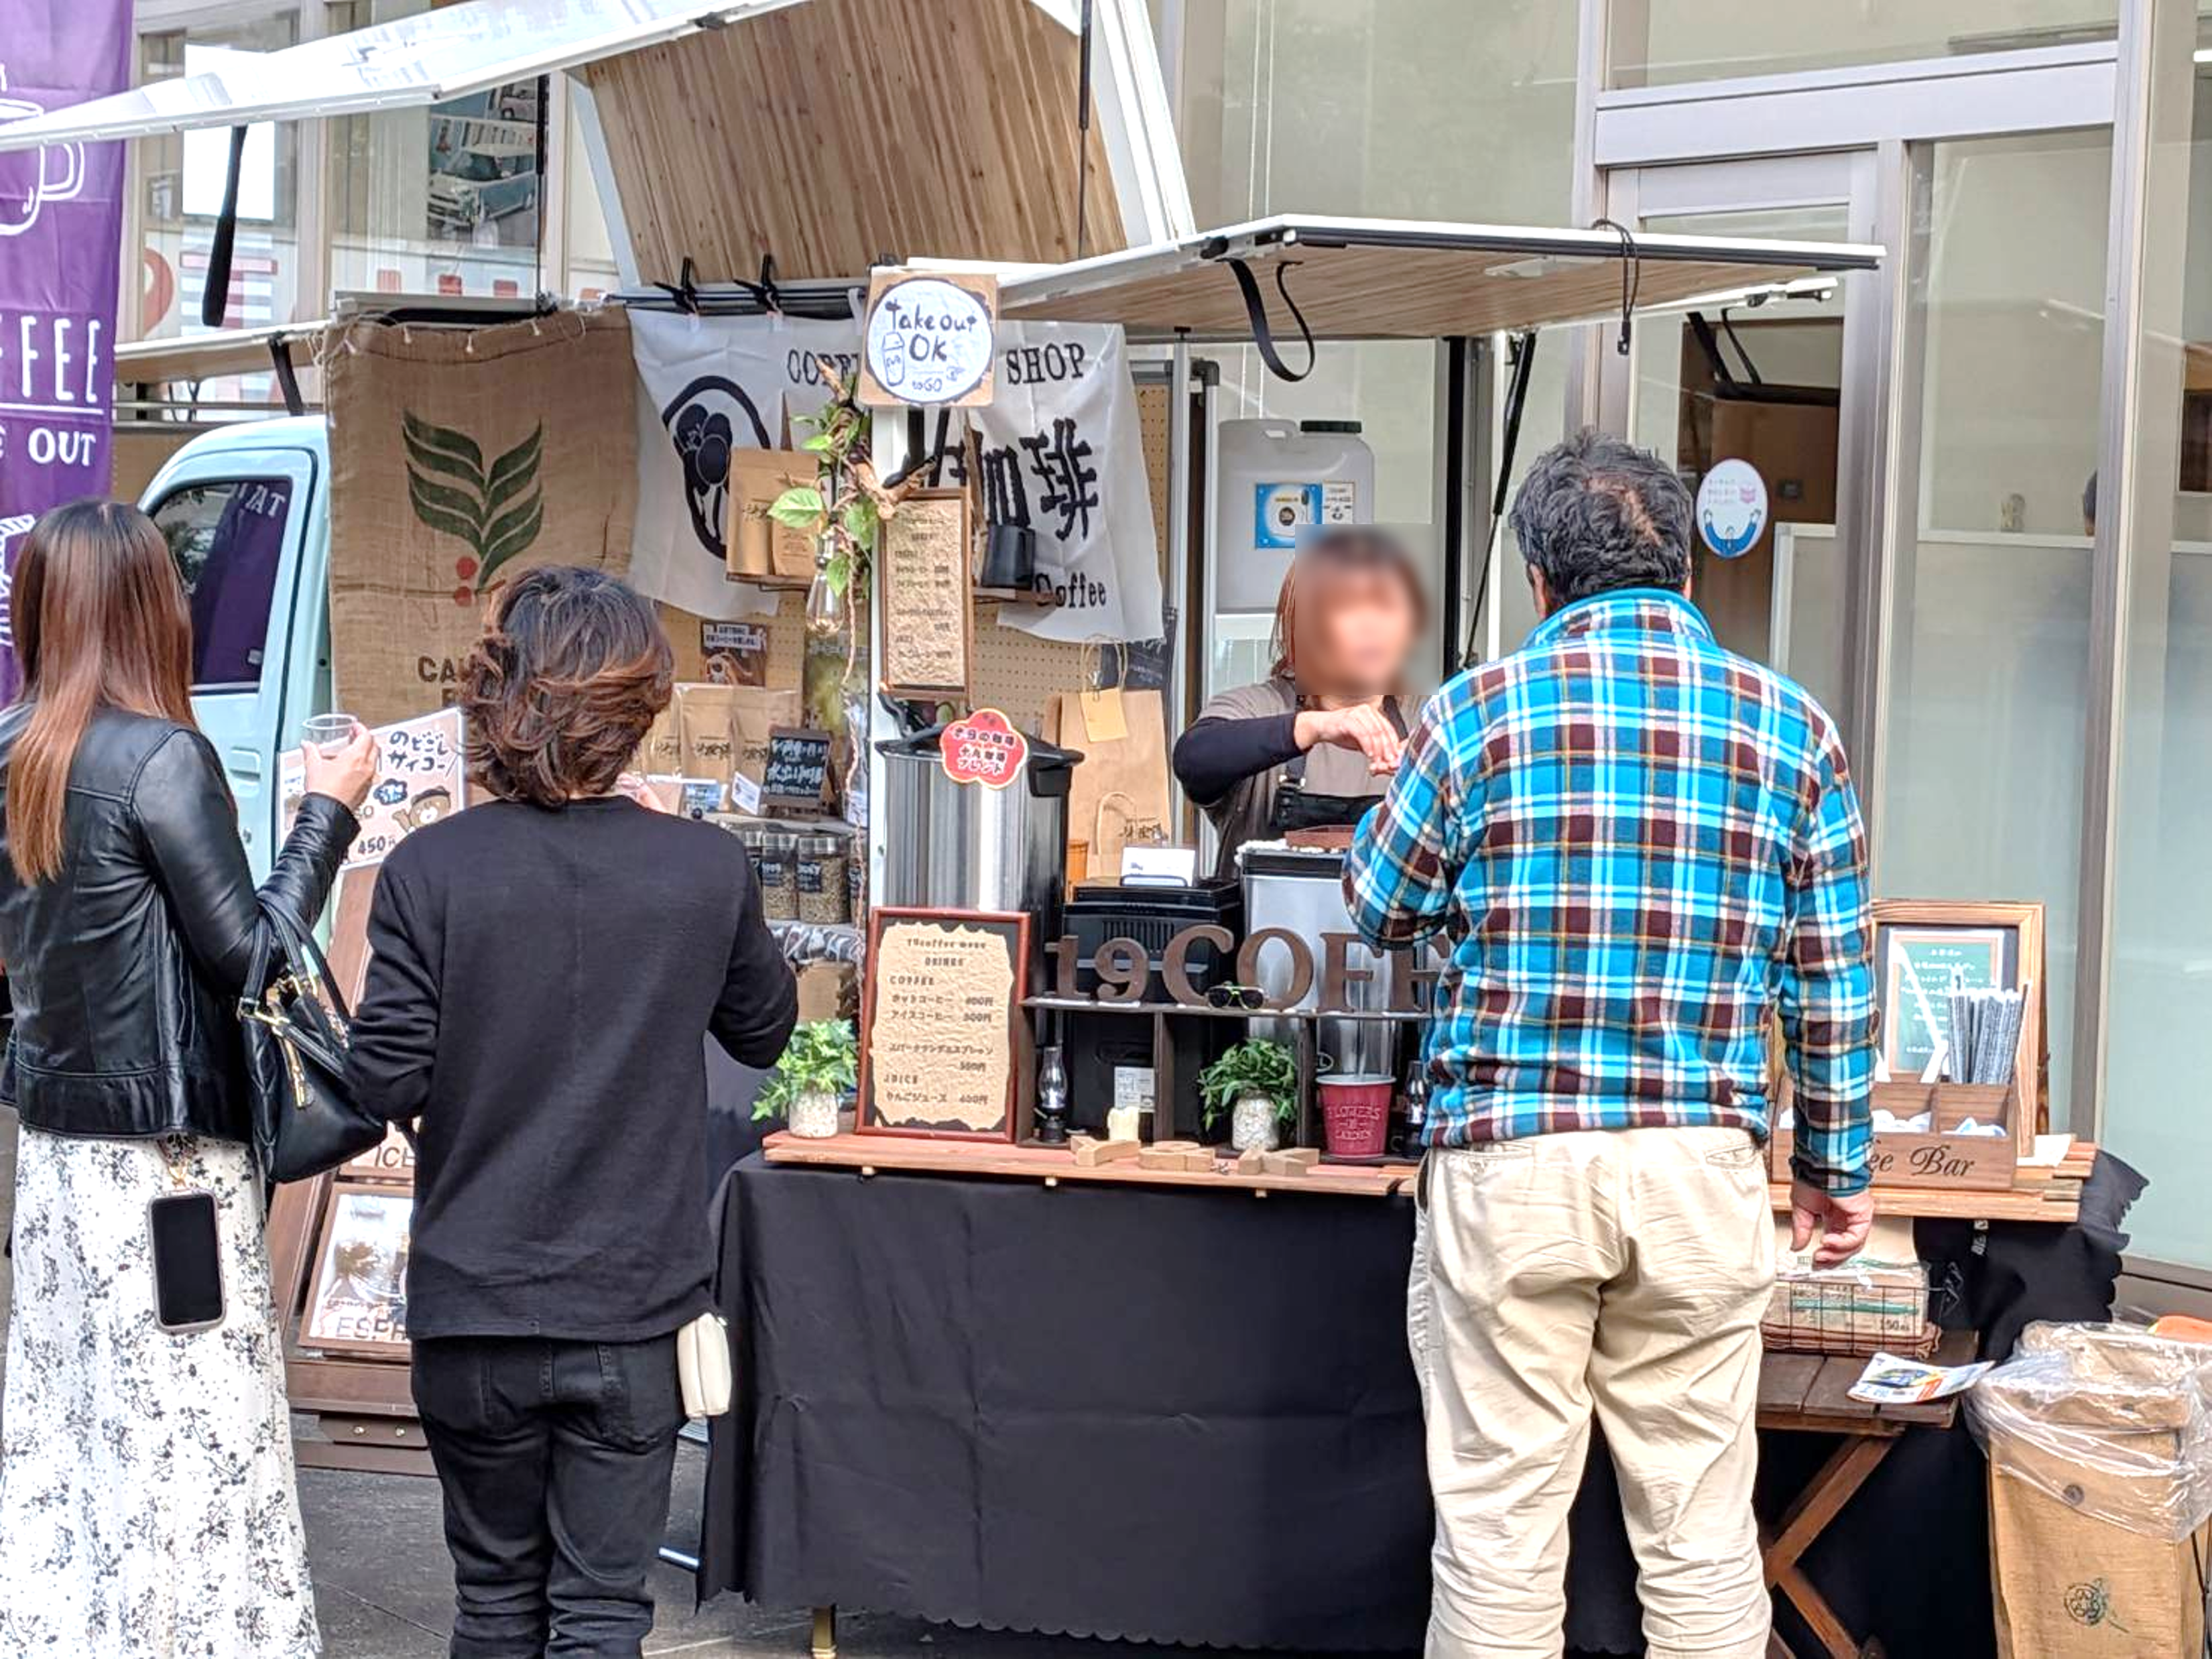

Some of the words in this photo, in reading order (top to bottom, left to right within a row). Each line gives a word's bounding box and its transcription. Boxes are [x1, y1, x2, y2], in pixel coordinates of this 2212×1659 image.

[885, 298, 935, 332] Take
[940, 310, 977, 332] out
[0, 314, 101, 403] FEE
[909, 334, 947, 361] OK
[1007, 343, 1085, 384] SHOP
[28, 428, 96, 466] OUT
[1034, 572, 1107, 608] Coffee
[418, 656, 465, 682] CA
[389, 731, 449, 755] のどごし
[388, 753, 446, 772] サイコー
[889, 976, 935, 985] COFFEE
[1910, 1144, 1975, 1177] Bar
